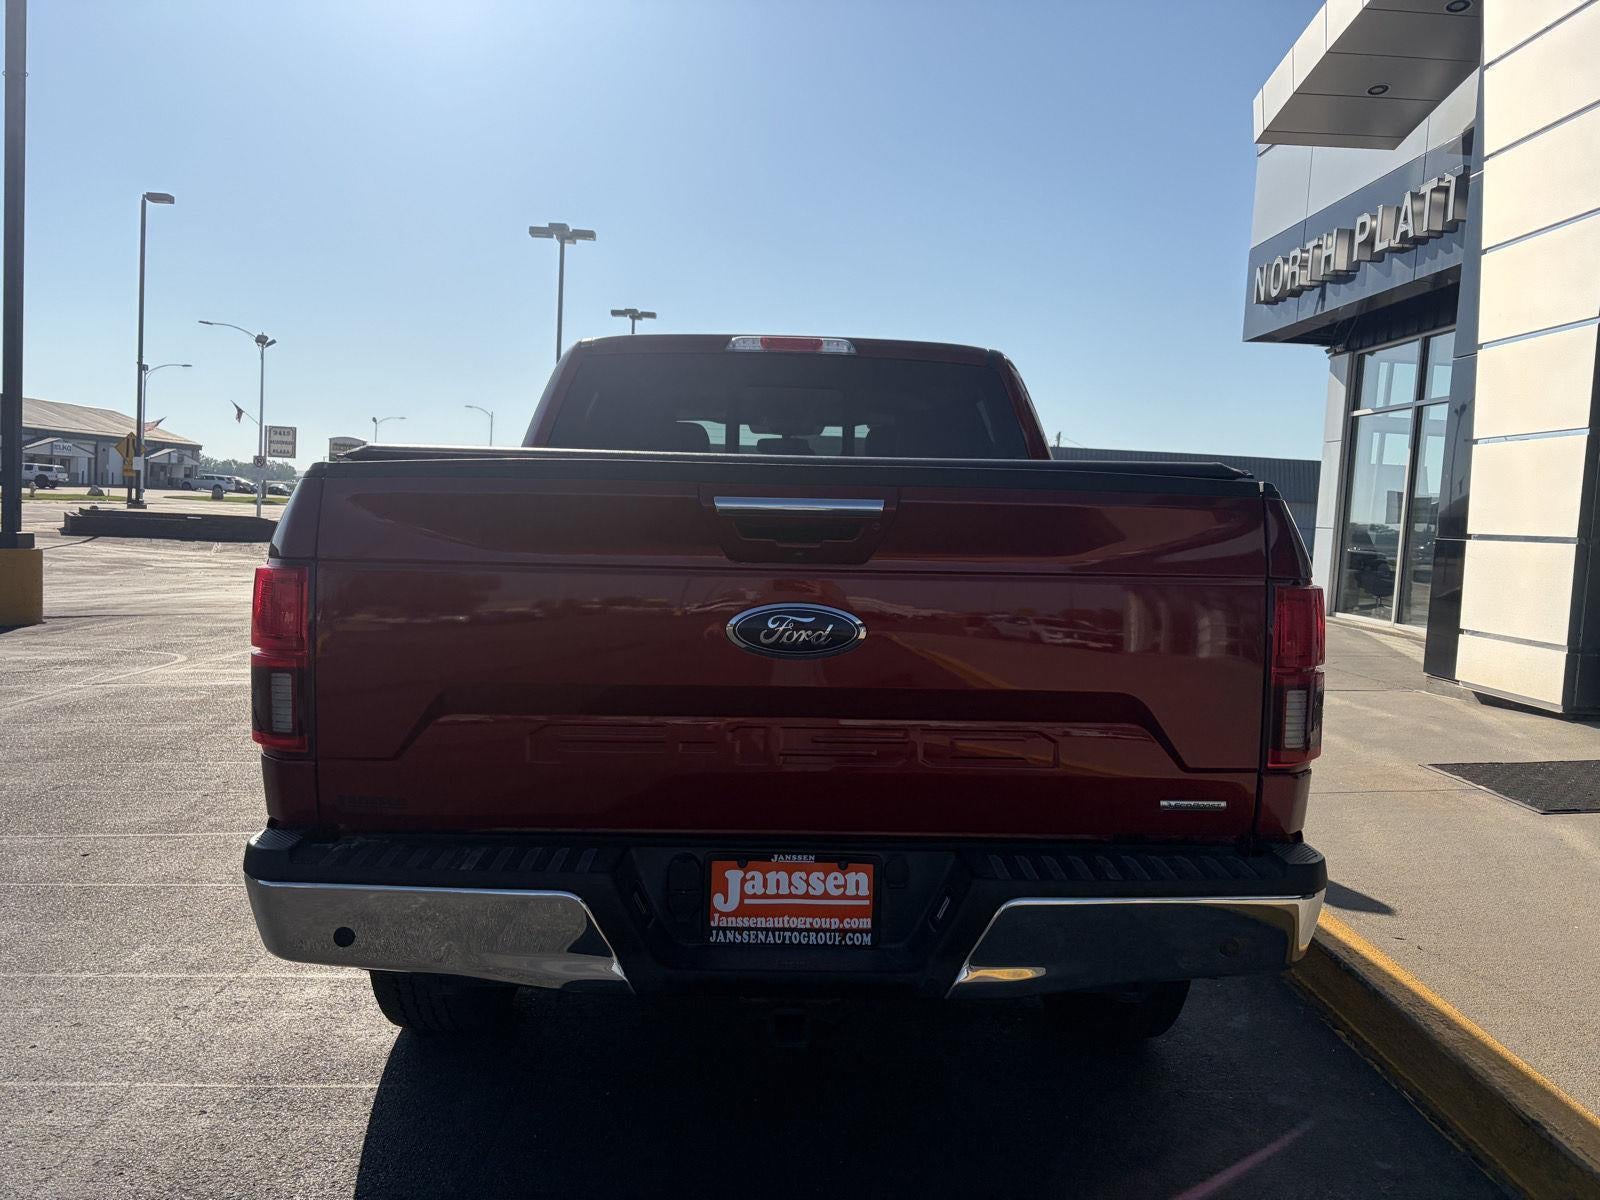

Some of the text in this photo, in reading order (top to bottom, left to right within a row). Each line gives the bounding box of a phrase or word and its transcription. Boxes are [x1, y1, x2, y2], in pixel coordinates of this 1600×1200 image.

[1254, 228, 1341, 304] NORTH
[760, 614, 834, 644] Ford
[771, 854, 815, 862] JANSSEN
[713, 870, 869, 912] Janssen
[711, 913, 872, 929] Janssenautogroup.com
